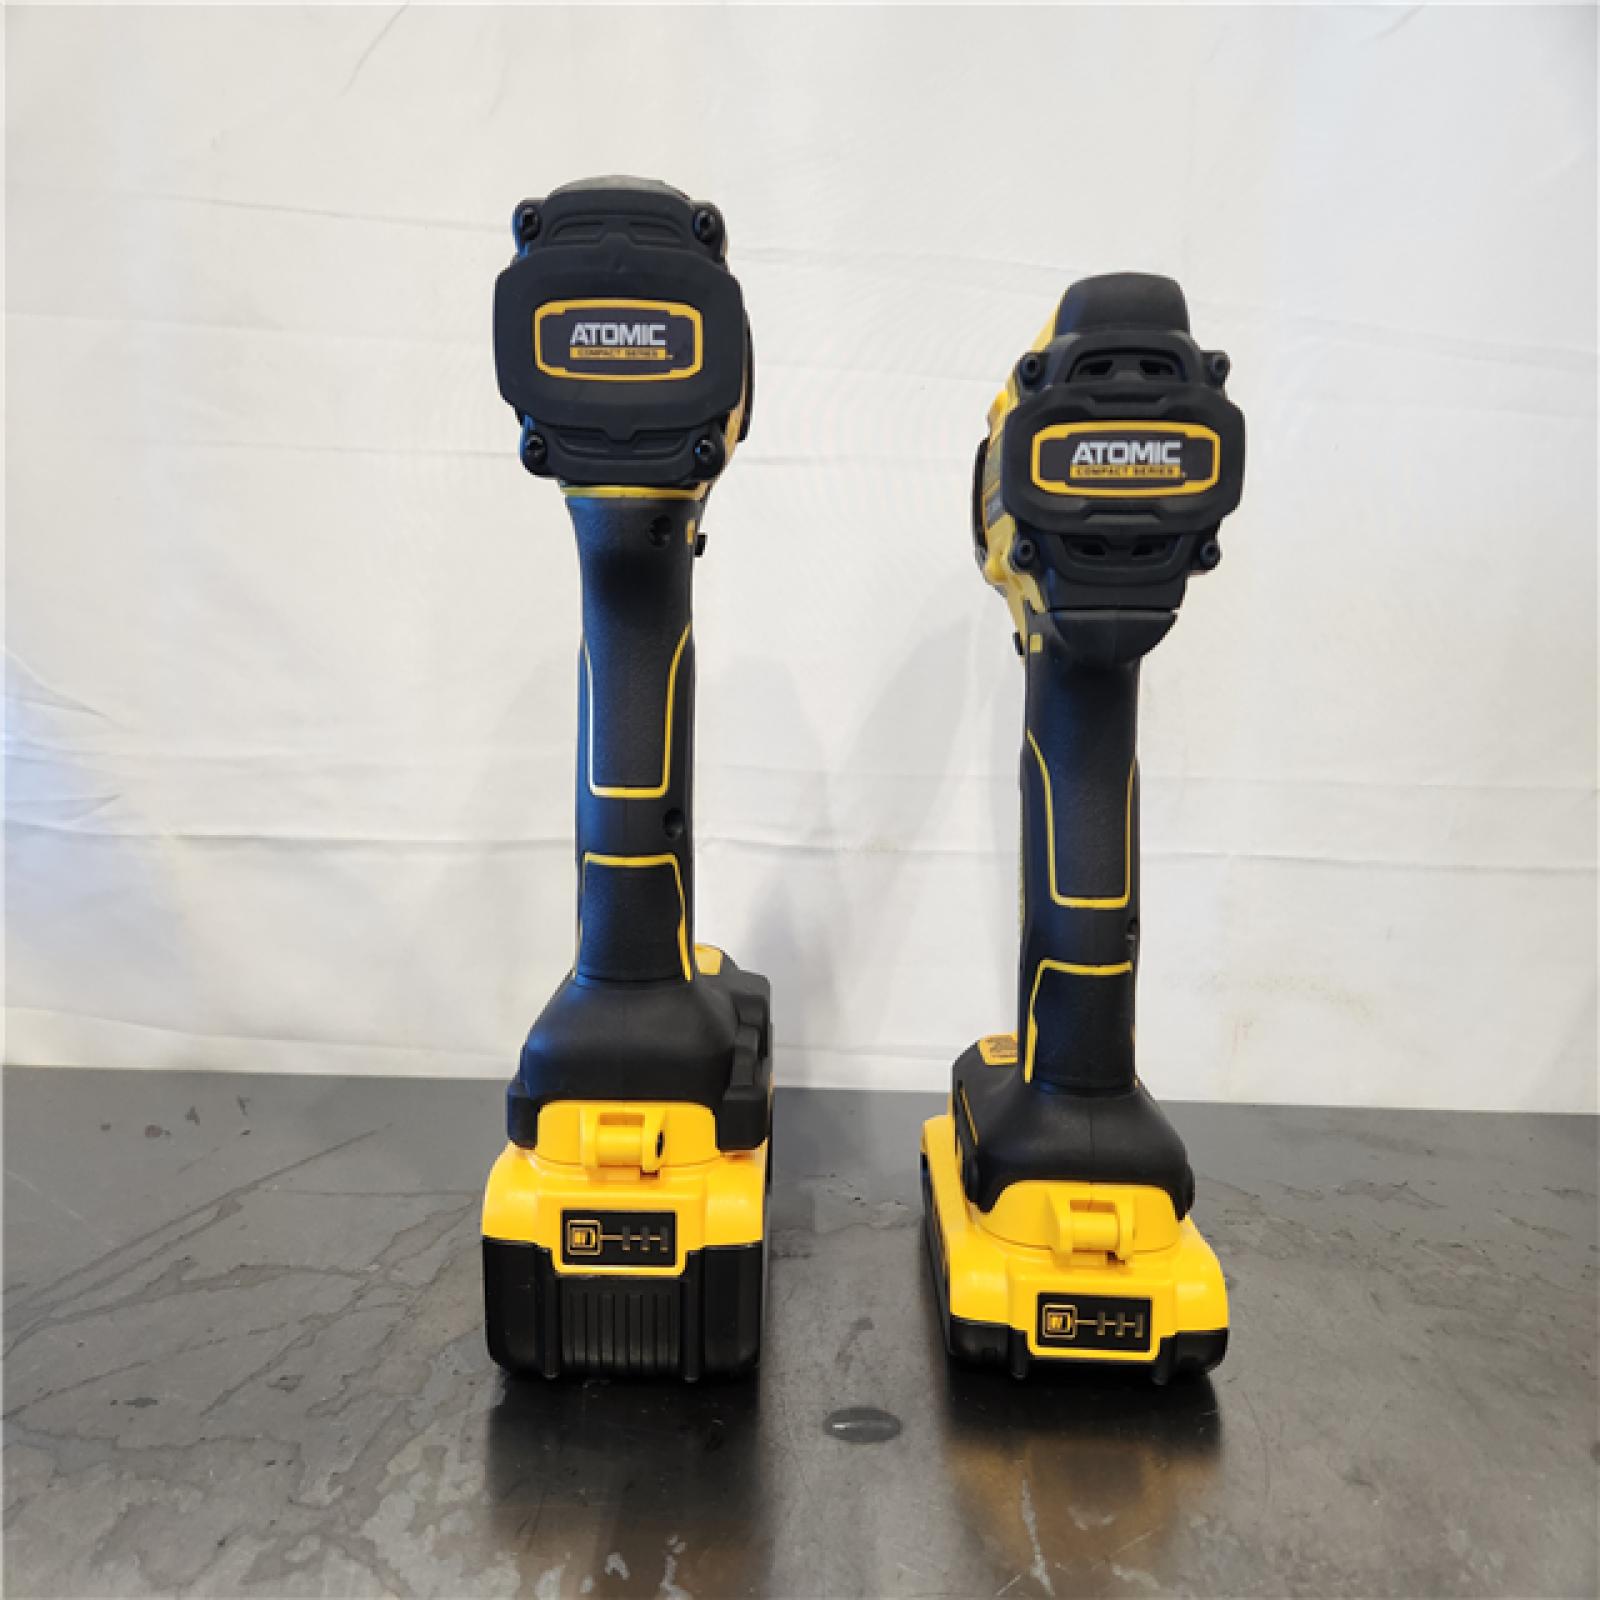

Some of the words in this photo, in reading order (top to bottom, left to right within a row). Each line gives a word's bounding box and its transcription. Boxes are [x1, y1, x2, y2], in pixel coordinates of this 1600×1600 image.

[570, 322, 666, 346] ATOMIC
[1071, 440, 1183, 465] ATOMIC
[1075, 466, 1128, 476] COMPACT
[1134, 466, 1175, 476] SERIES
